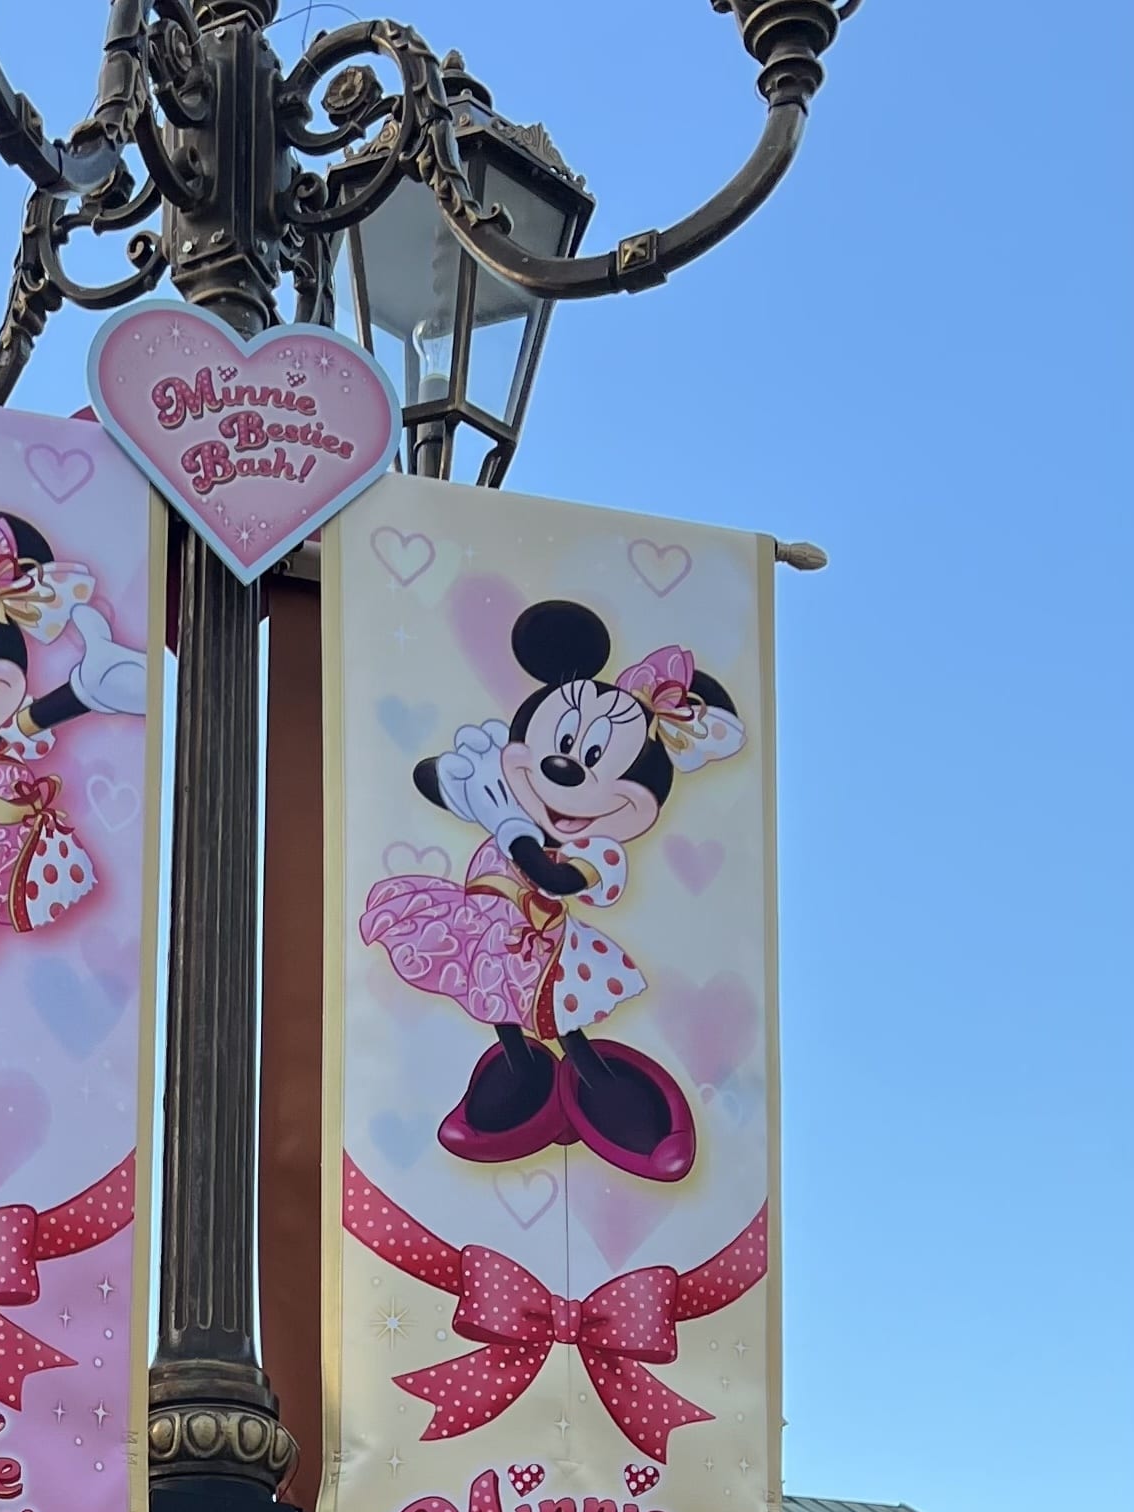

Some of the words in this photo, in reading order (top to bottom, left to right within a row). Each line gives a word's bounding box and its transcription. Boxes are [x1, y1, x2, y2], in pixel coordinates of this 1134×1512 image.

[152, 366, 316, 429] Minnie
[219, 410, 354, 460] Besties
[181, 440, 316, 494] Bash!
